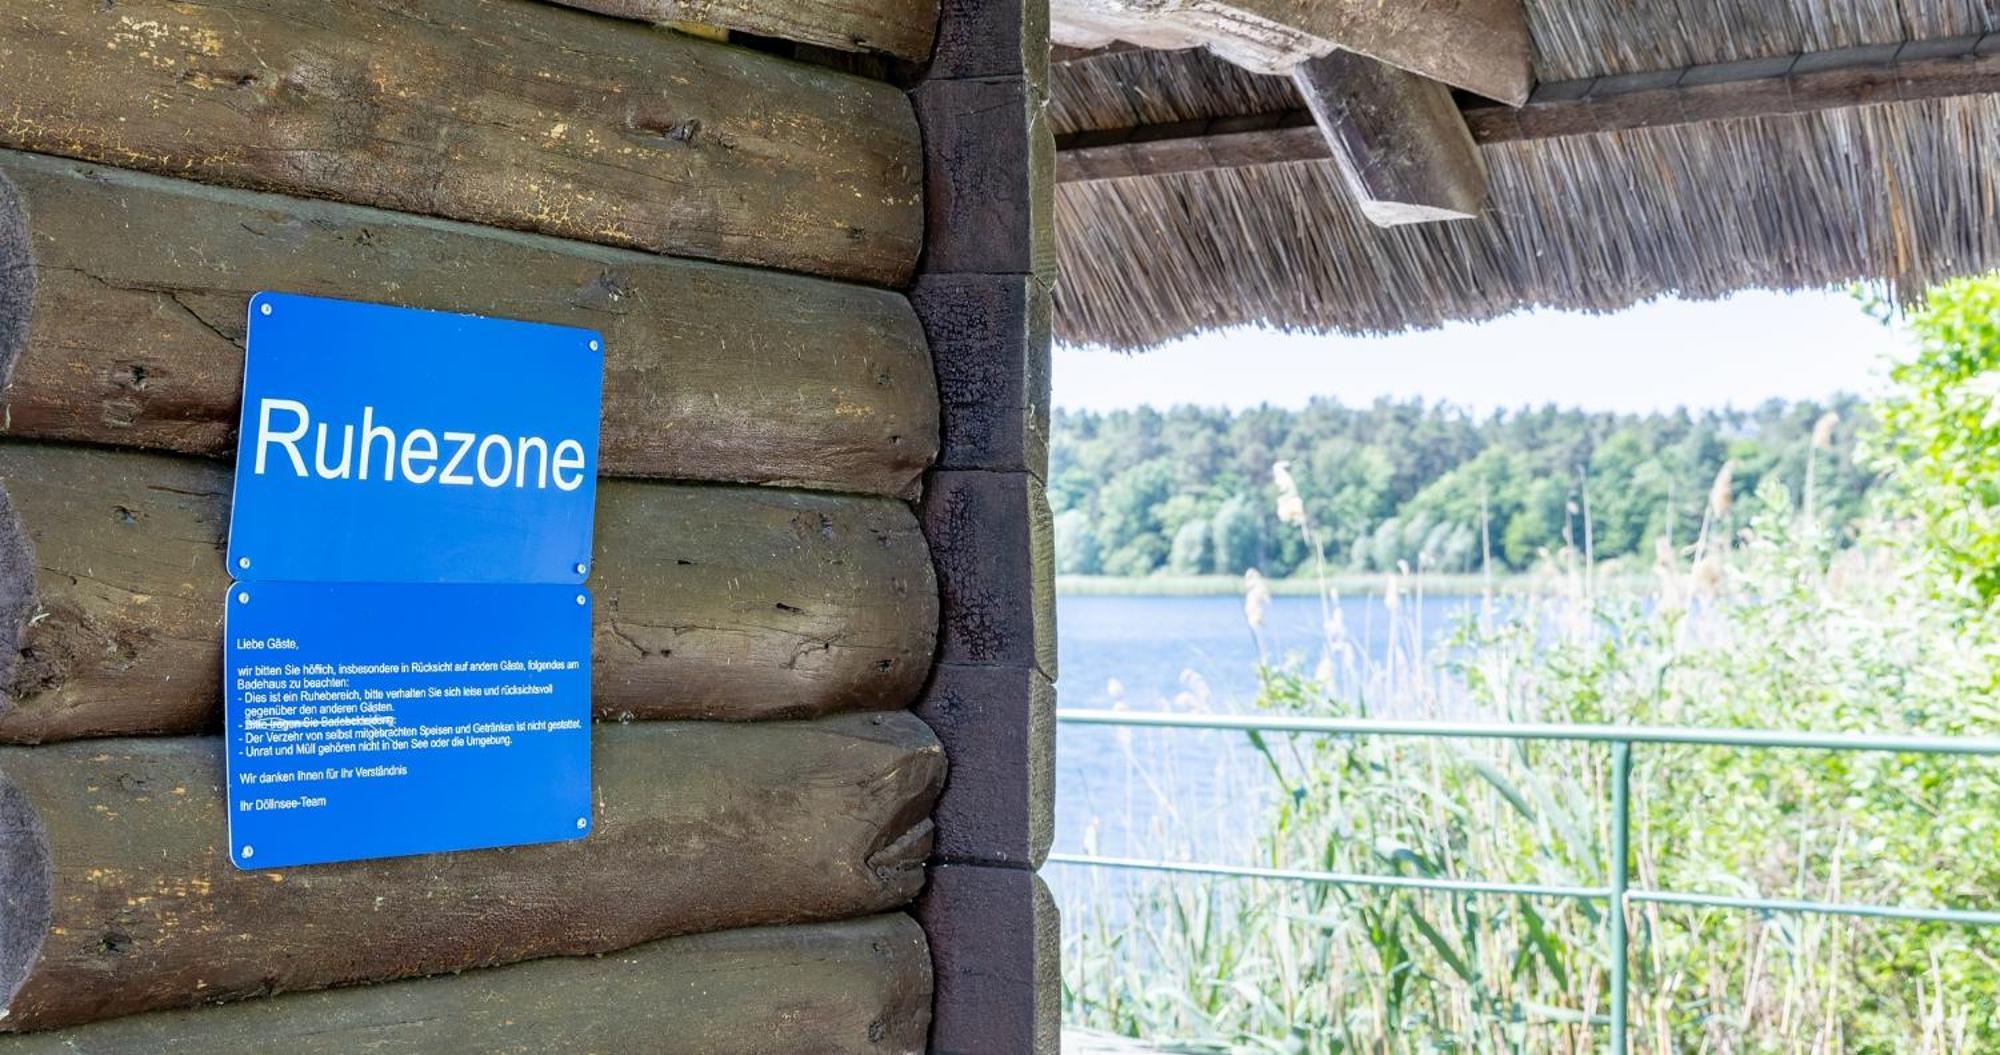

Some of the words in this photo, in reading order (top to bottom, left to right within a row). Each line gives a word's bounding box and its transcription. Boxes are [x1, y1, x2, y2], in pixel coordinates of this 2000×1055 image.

[255, 398, 585, 491] Ruhezone
[236, 637, 265, 650] Liebe
[266, 637, 300, 650] Gäste,
[237, 665, 253, 676] wir
[255, 665, 282, 676] bitten
[284, 664, 301, 675] Sie
[338, 662, 399, 675] insbesondere
[400, 662, 410, 672] in
[411, 662, 453, 673] Rücksicht
[454, 661, 469, 672] auf
[470, 660, 498, 672] andere
[500, 660, 527, 672] Gäste,
[527, 660, 565, 672] folgendes
[566, 661, 580, 670] am
[236, 678, 287, 690] Badehaus
[289, 679, 301, 689] zu
[303, 677, 349, 689] beachten:
[245, 692, 268, 703] Dies
[269, 691, 281, 702] ist
[283, 691, 298, 702] ein
[300, 689, 362, 702] Ruhebereich,
[364, 688, 384, 700] bitte
[386, 687, 426, 700] verhalten
[428, 686, 442, 697] Sie
[444, 686, 461, 697] sich
[463, 685, 482, 697] leise
[484, 685, 500, 696] und
[501, 683, 553, 695] rücksichtsvoll
[244, 704, 297, 718] gegenüber
[299, 703, 317, 714] den
[319, 702, 358, 714] anderen
[359, 701, 396, 713] Gästen.
[245, 732, 264, 744] Der
[265, 731, 303, 743] Verzehr
[305, 731, 324, 740] von
[325, 729, 353, 740] selbst
[354, 726, 417, 740] mitgebrachten
[419, 724, 453, 737] Speisen
[455, 723, 471, 734] und
[472, 722, 515, 734] Getränken
[516, 721, 526, 731] ist
[527, 720, 546, 731] nicht
[245, 744, 273, 757] Unrat
[275, 744, 294, 756] und
[295, 742, 316, 755] Müll
[318, 741, 357, 756] gehören
[358, 740, 380, 751] nicht
[382, 739, 390, 750] in
[391, 738, 409, 750] den
[410, 738, 429, 749] See
[430, 737, 450, 747] oder
[451, 736, 465, 747] die
[466, 734, 513, 747] Umgebung.
[239, 772, 257, 784] Wir
[259, 771, 296, 783] danken
[297, 769, 324, 780] Ihnen
[326, 767, 339, 779] für
[340, 767, 354, 778] Ihr
[355, 764, 408, 777] Verständnis
[239, 800, 253, 811] Ihr
[255, 795, 327, 810] Döllnsee-Team
